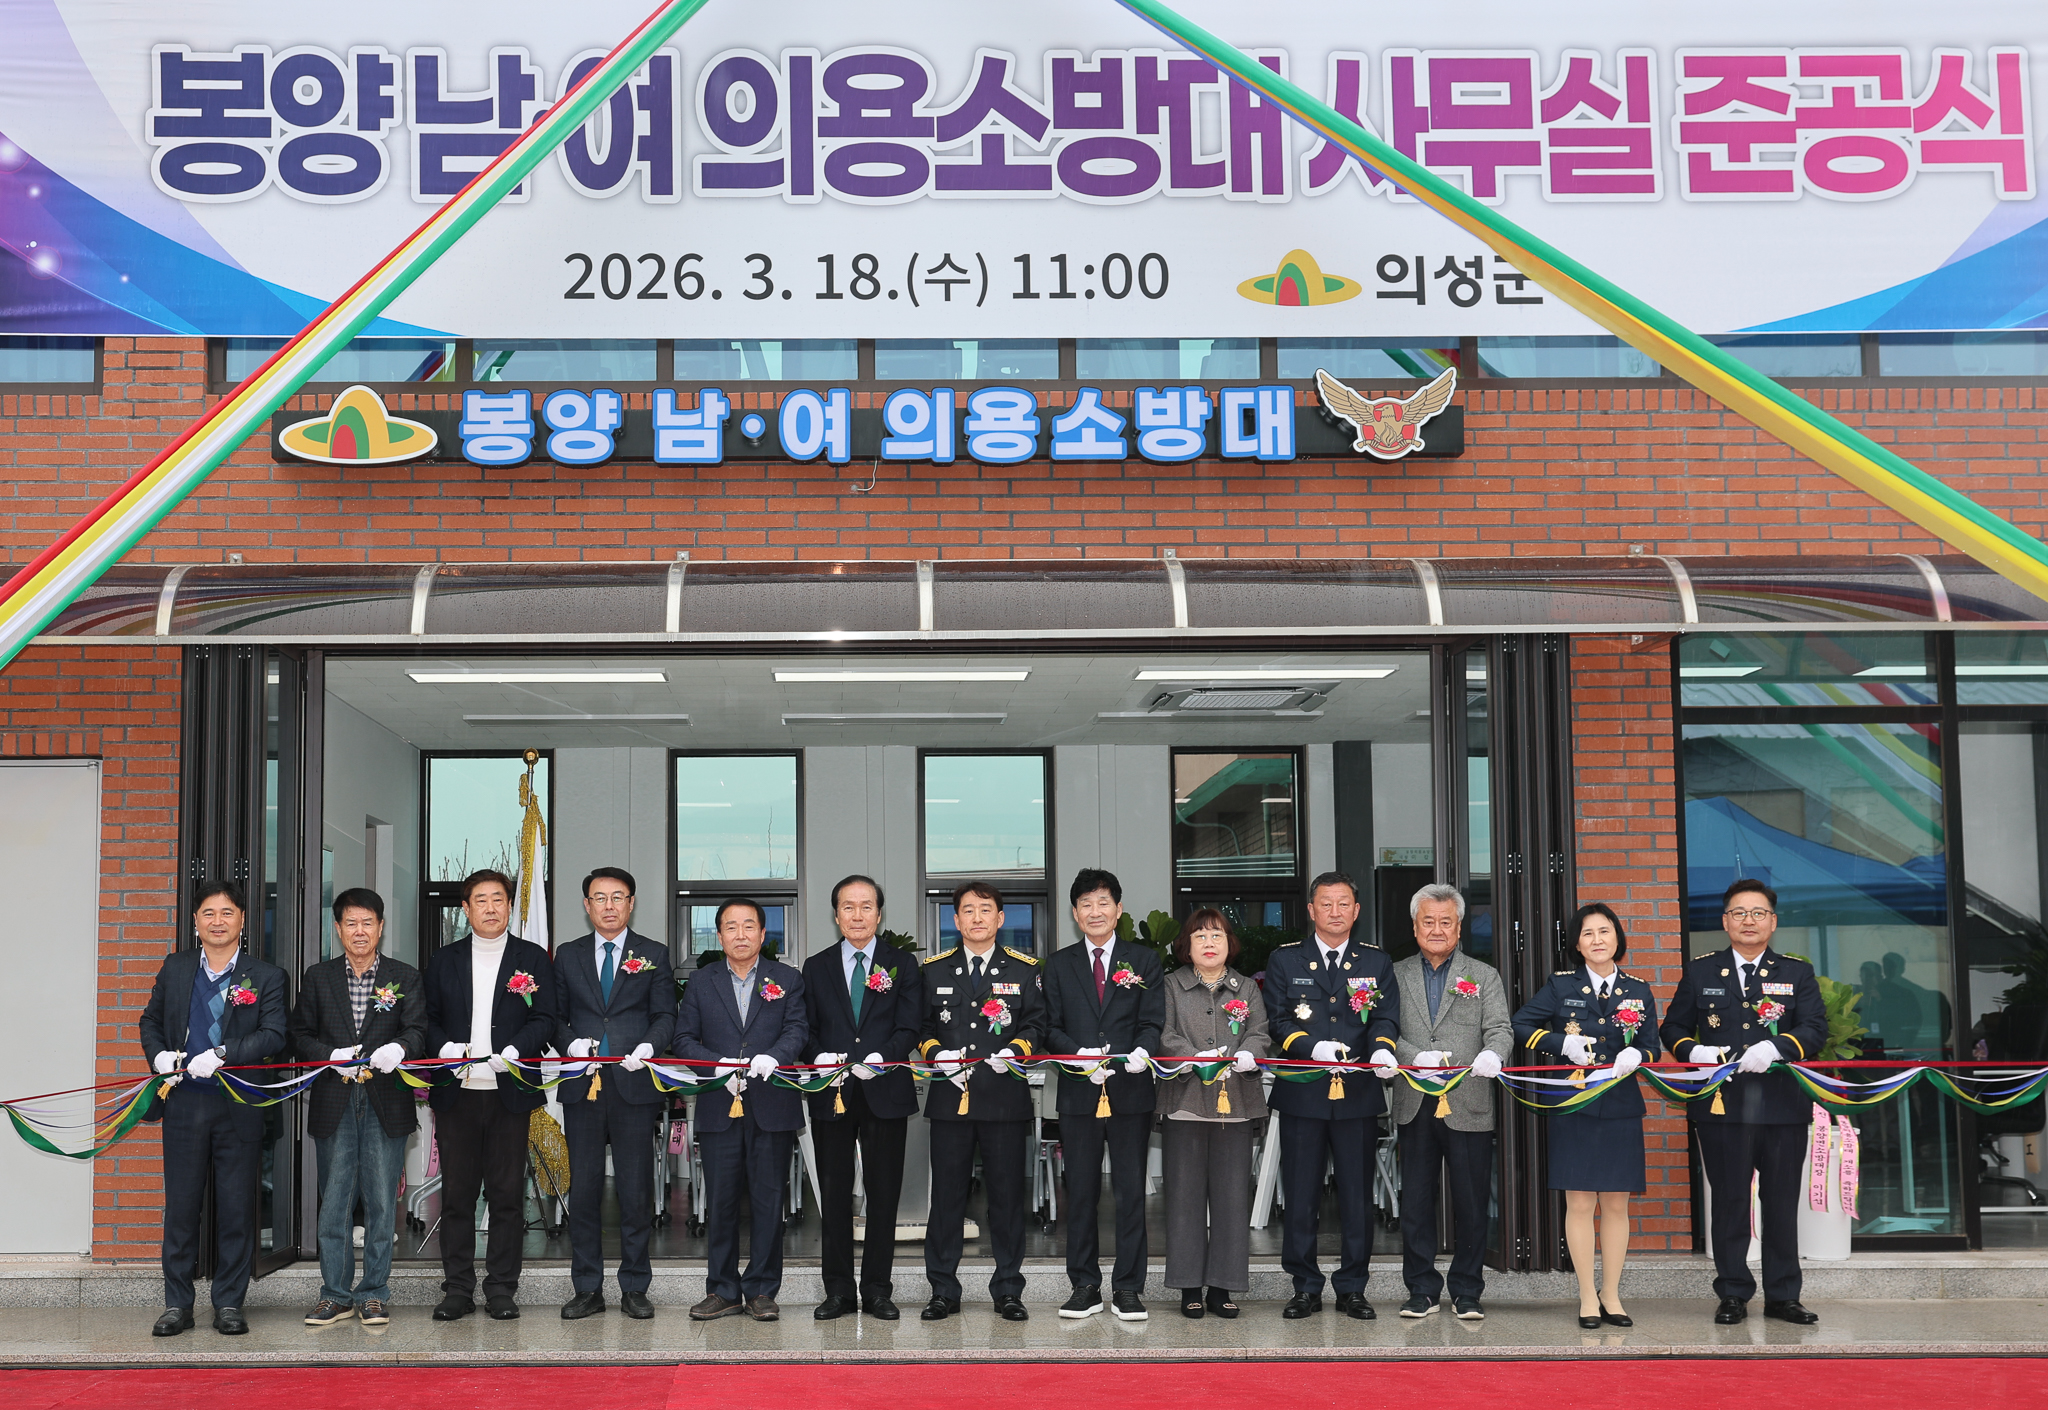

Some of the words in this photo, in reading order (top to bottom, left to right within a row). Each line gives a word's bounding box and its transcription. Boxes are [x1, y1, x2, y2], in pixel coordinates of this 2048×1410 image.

[154, 52, 394, 195] 봉양
[702, 54, 1284, 197] 의용소방대
[1309, 56, 1655, 197] 사무실
[1680, 53, 2028, 193] 준공식
[563, 253, 722, 300] 2026.
[742, 253, 792, 300] 3.
[816, 252, 988, 307] 18.(수)
[1012, 253, 1169, 300] 11:00
[461, 389, 623, 466] 봉양
[881, 386, 1295, 463] 의용소방대
